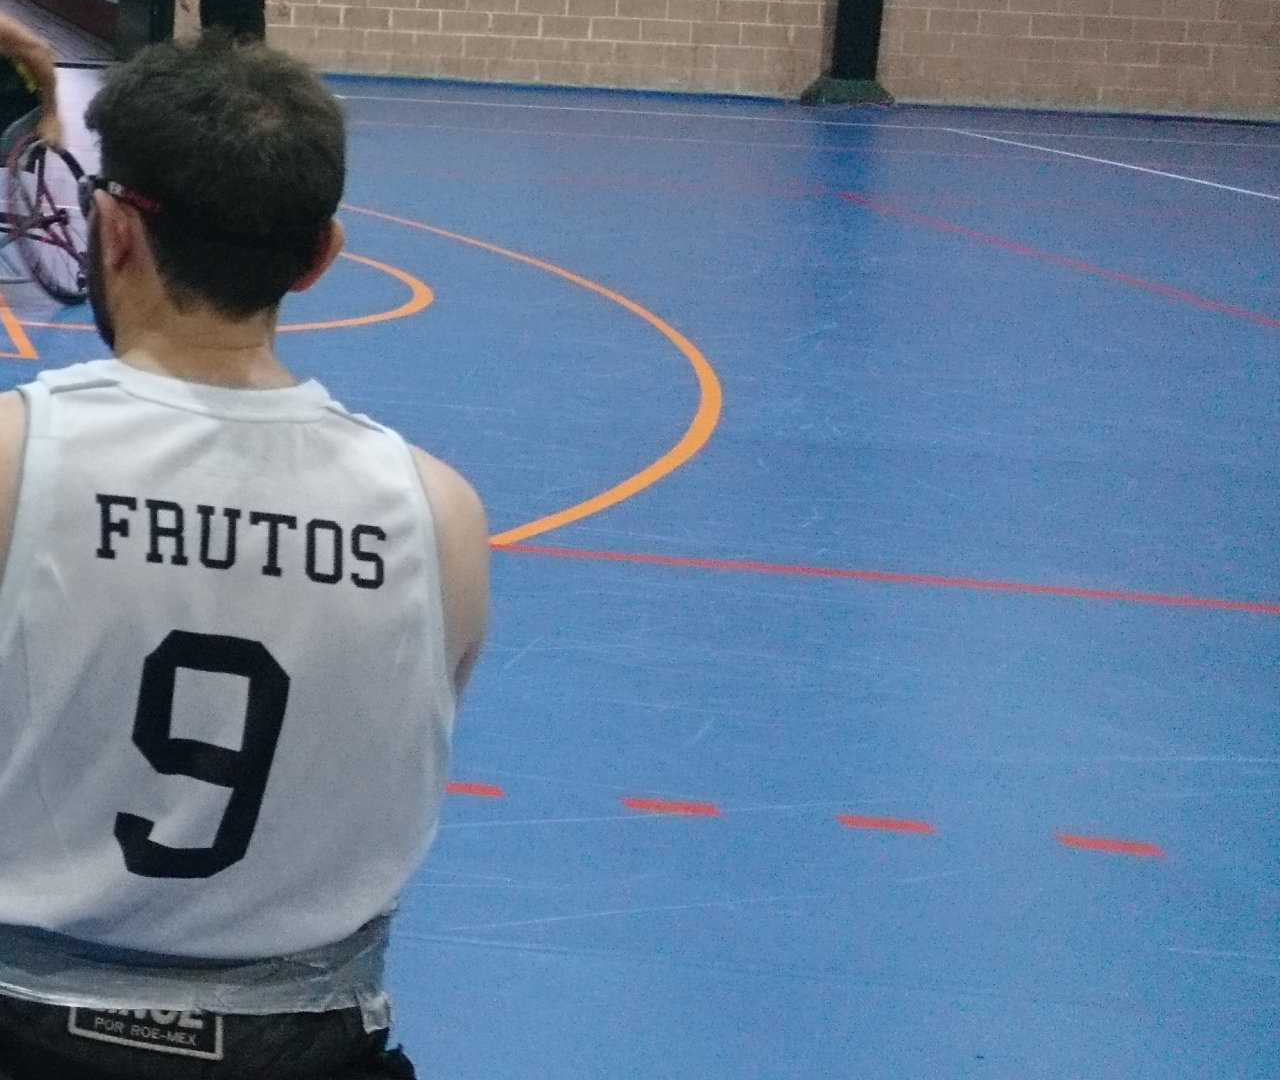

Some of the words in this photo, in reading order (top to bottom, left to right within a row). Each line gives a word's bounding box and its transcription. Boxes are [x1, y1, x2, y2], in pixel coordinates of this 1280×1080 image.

[96, 493, 387, 590] FRUTOS
[113, 629, 290, 879] 9
[94, 1017, 124, 1033] POR
